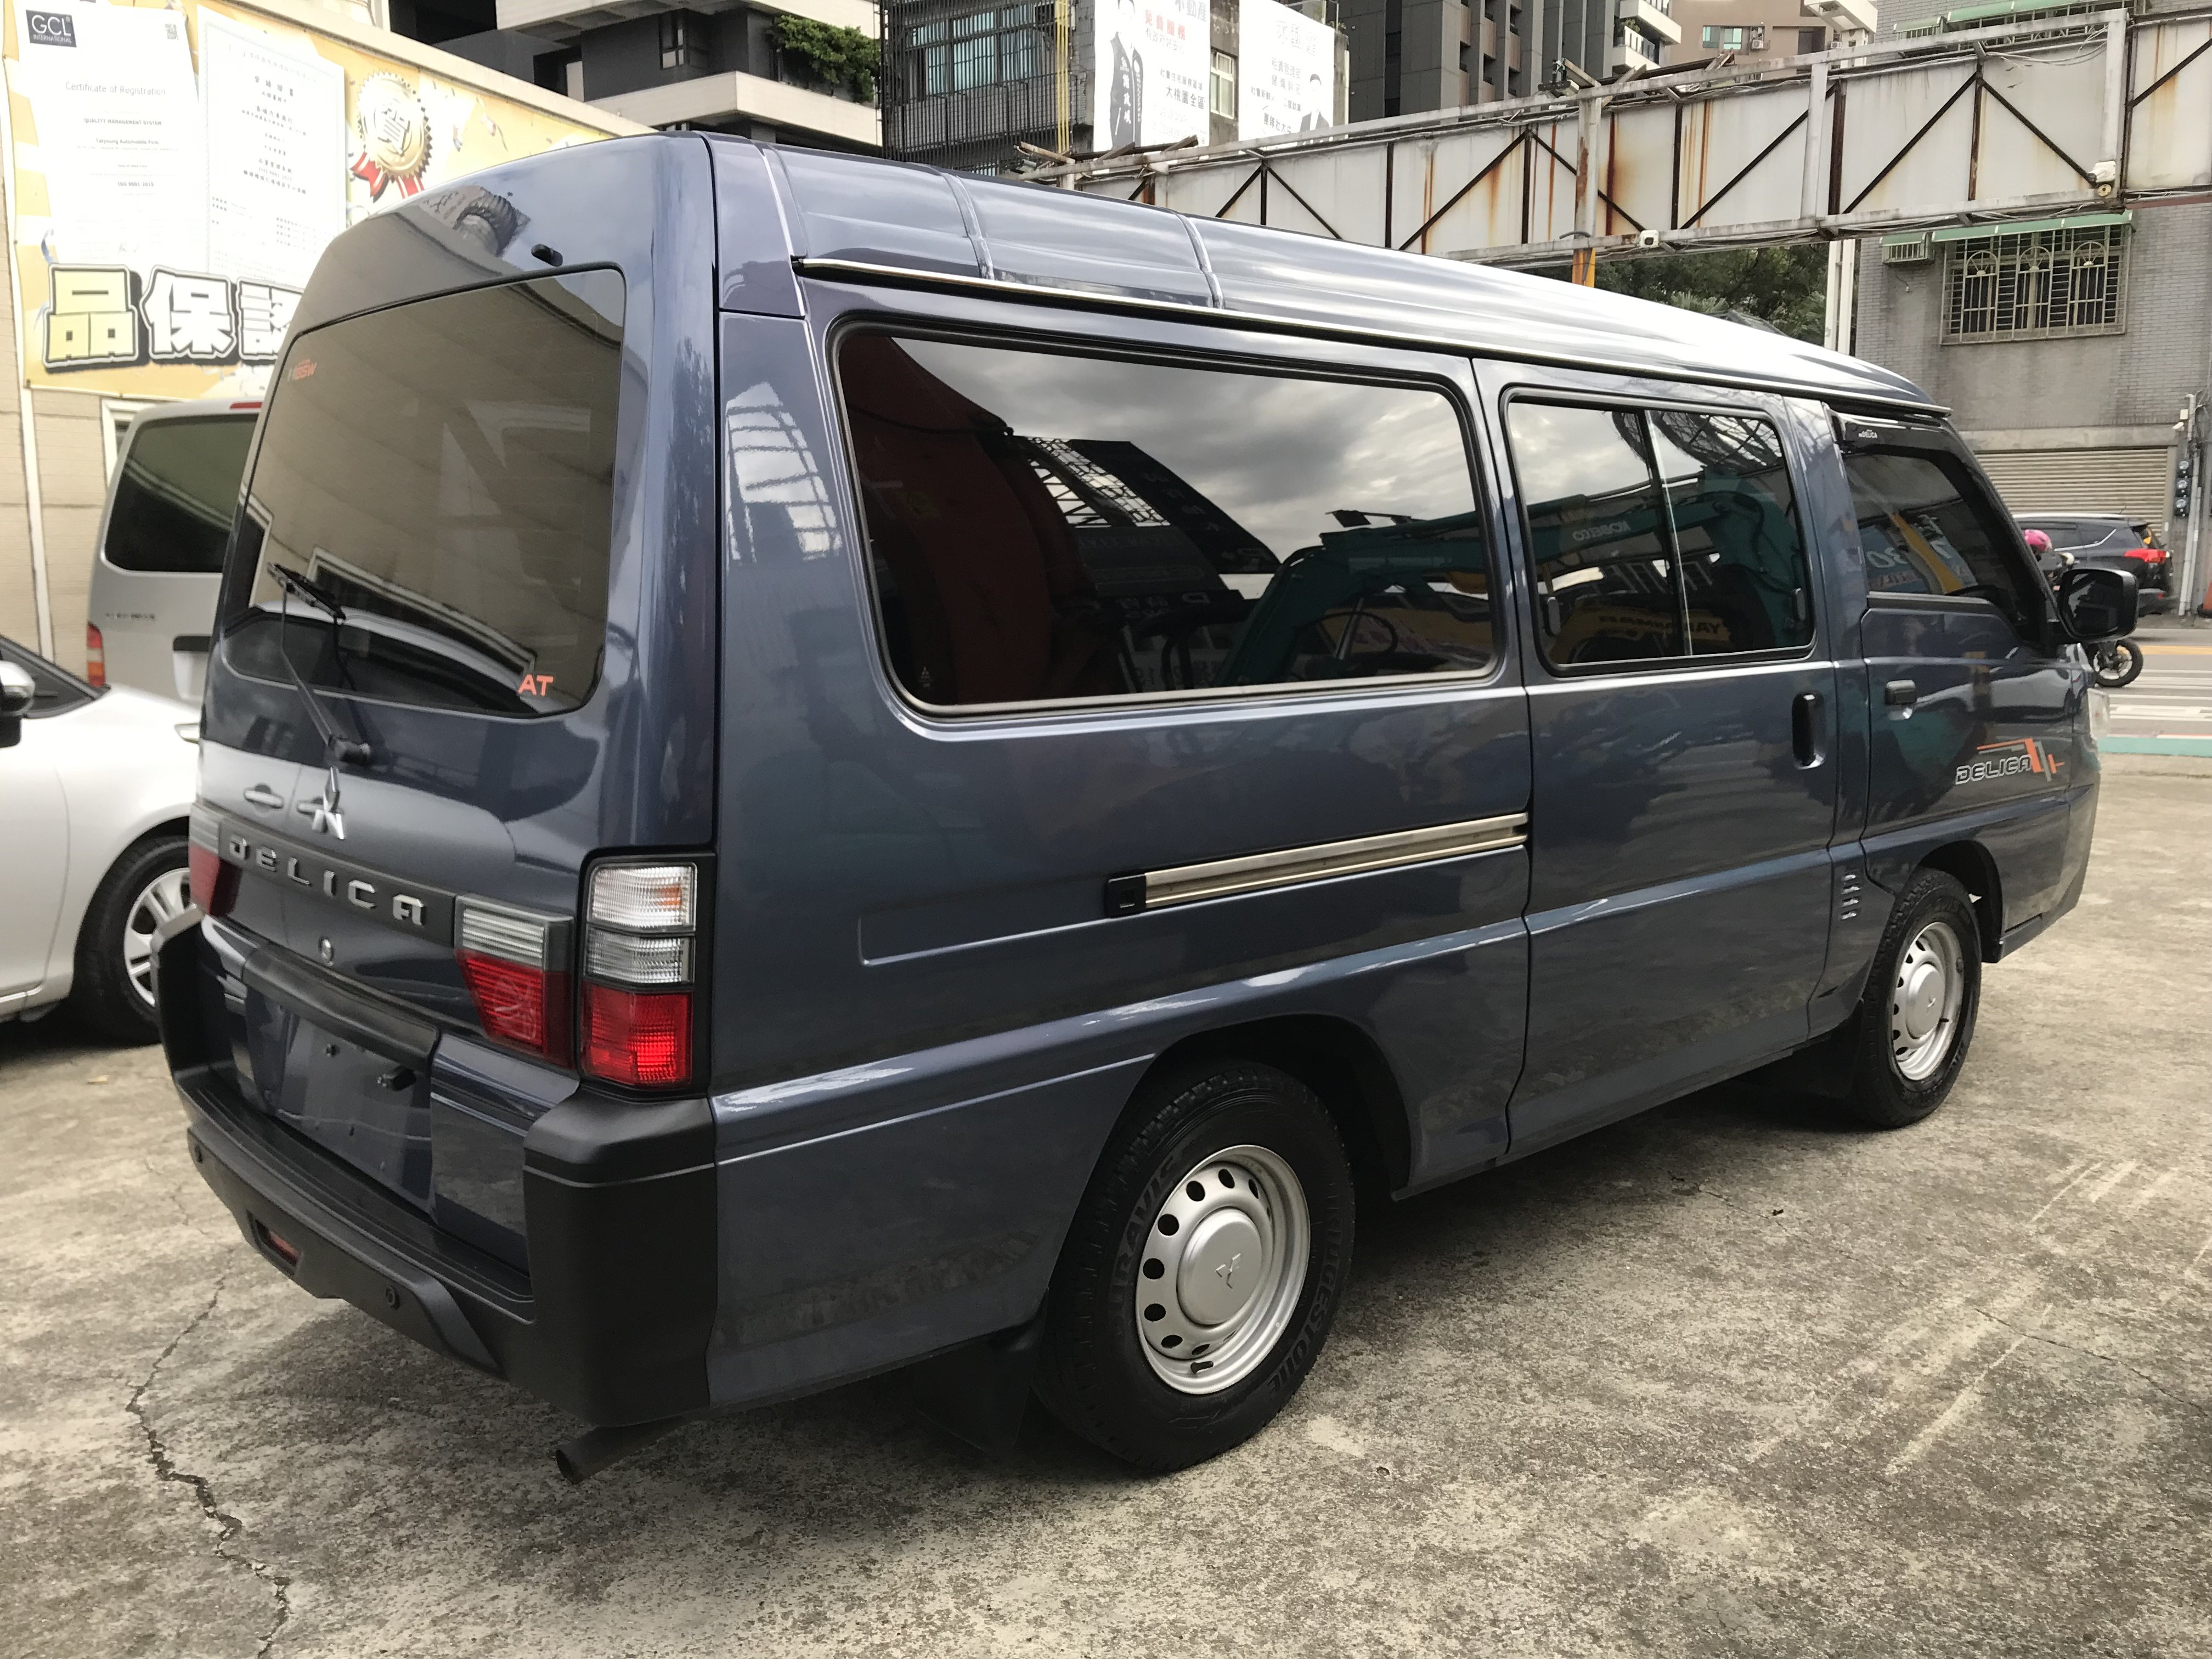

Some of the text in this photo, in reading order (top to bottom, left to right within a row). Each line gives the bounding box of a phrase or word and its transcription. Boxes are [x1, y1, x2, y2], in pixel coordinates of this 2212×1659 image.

[31, 14, 72, 37] GCL
[33, 34, 72, 44] INTERNATIONAL
[65, 81, 166, 96] Certificate of Registration
[1166, 84, 1205, 110] 大桃園全區
[518, 674, 554, 697] AT
[1955, 754, 2032, 785] DELICA
[228, 834, 426, 926] DELICA
